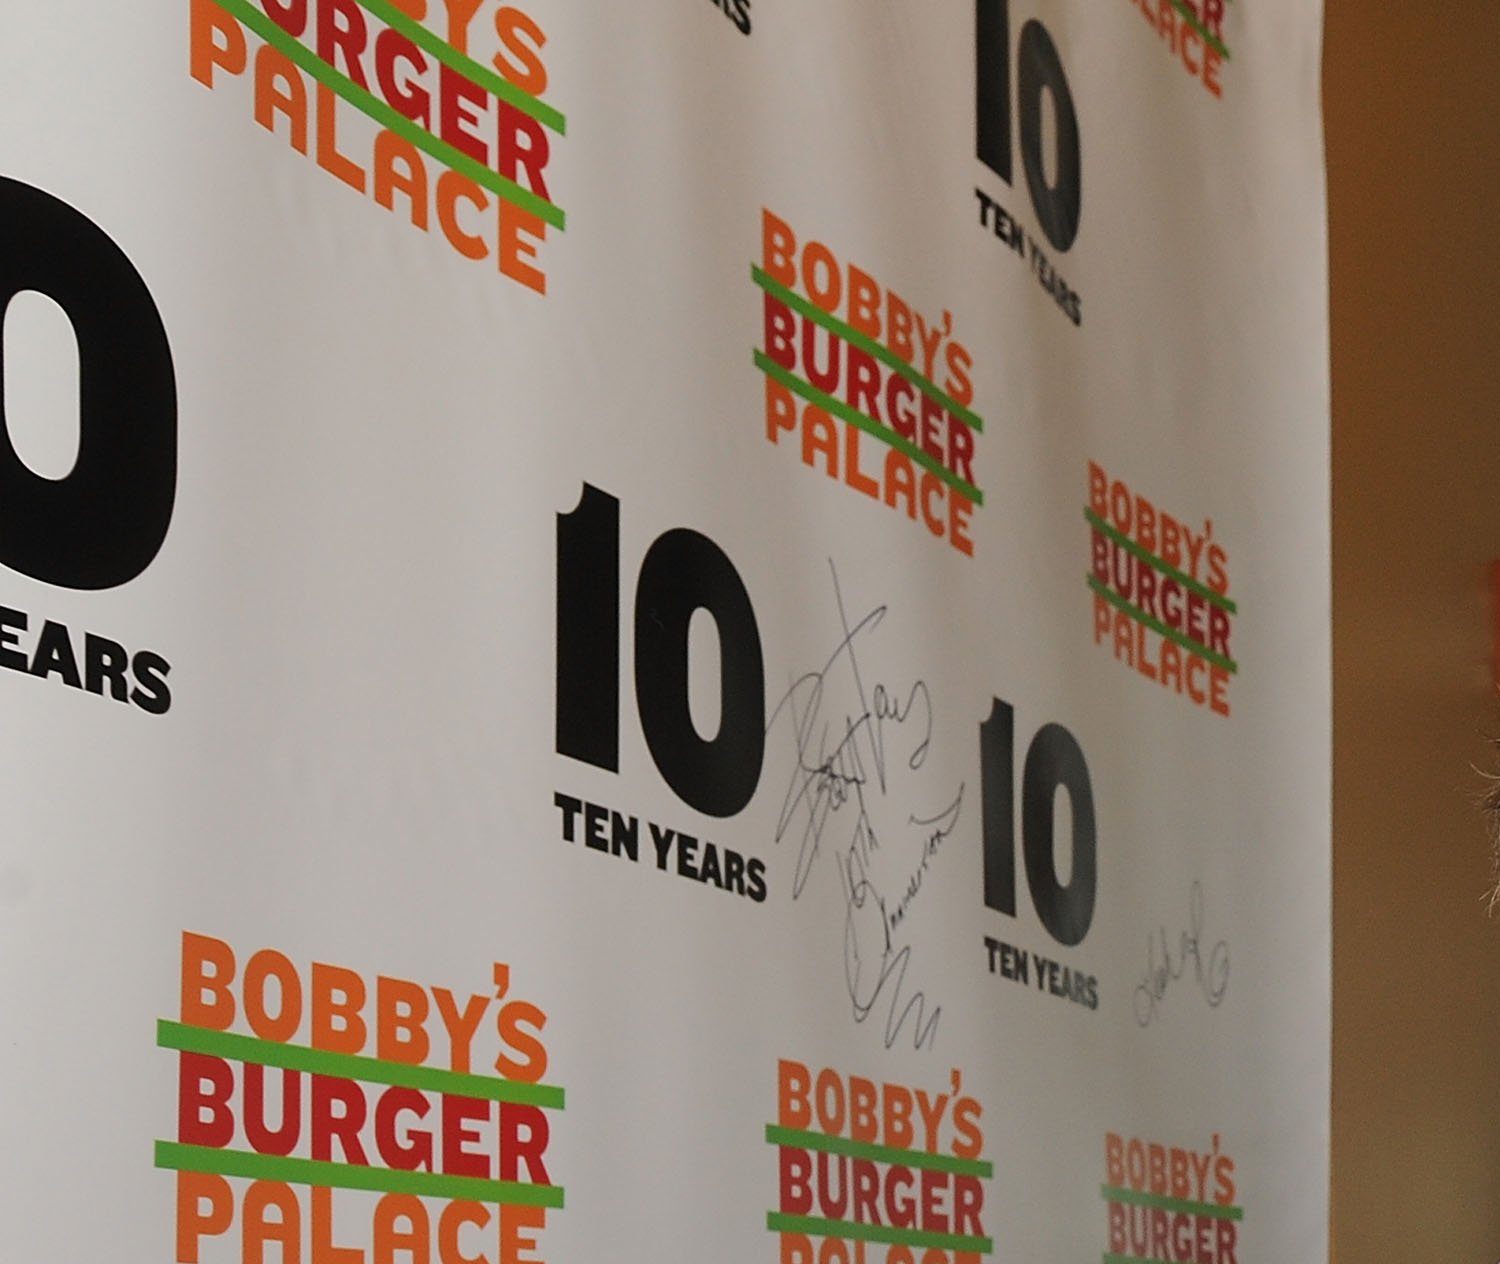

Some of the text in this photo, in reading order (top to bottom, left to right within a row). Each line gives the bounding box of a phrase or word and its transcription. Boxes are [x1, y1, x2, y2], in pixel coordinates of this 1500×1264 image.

[190, 0, 547, 296] PALACE
[975, 0, 1081, 253] 10
[763, 208, 974, 407] BOBBY'S
[974, 187, 1081, 328] TEN YEARS
[764, 294, 975, 483] BURGER
[765, 375, 974, 557] PALACE
[1089, 460, 1229, 597] BOBBY'S
[0, 606, 172, 715] EARS
[556, 481, 766, 818] 10
[1091, 527, 1230, 661] BURGER
[1094, 593, 1230, 717] PALACE
[554, 791, 768, 904] TEN YEARS
[980, 696, 1097, 948] 10
[180, 930, 548, 1083] BOBBY'S
[984, 936, 1099, 1011] TEN YEARS
[178, 1051, 551, 1185] BURGER
[778, 1059, 983, 1159] BOBBY'S
[1106, 1133, 1236, 1205] BOBBY'S
[779, 1147, 984, 1234] BURGER
